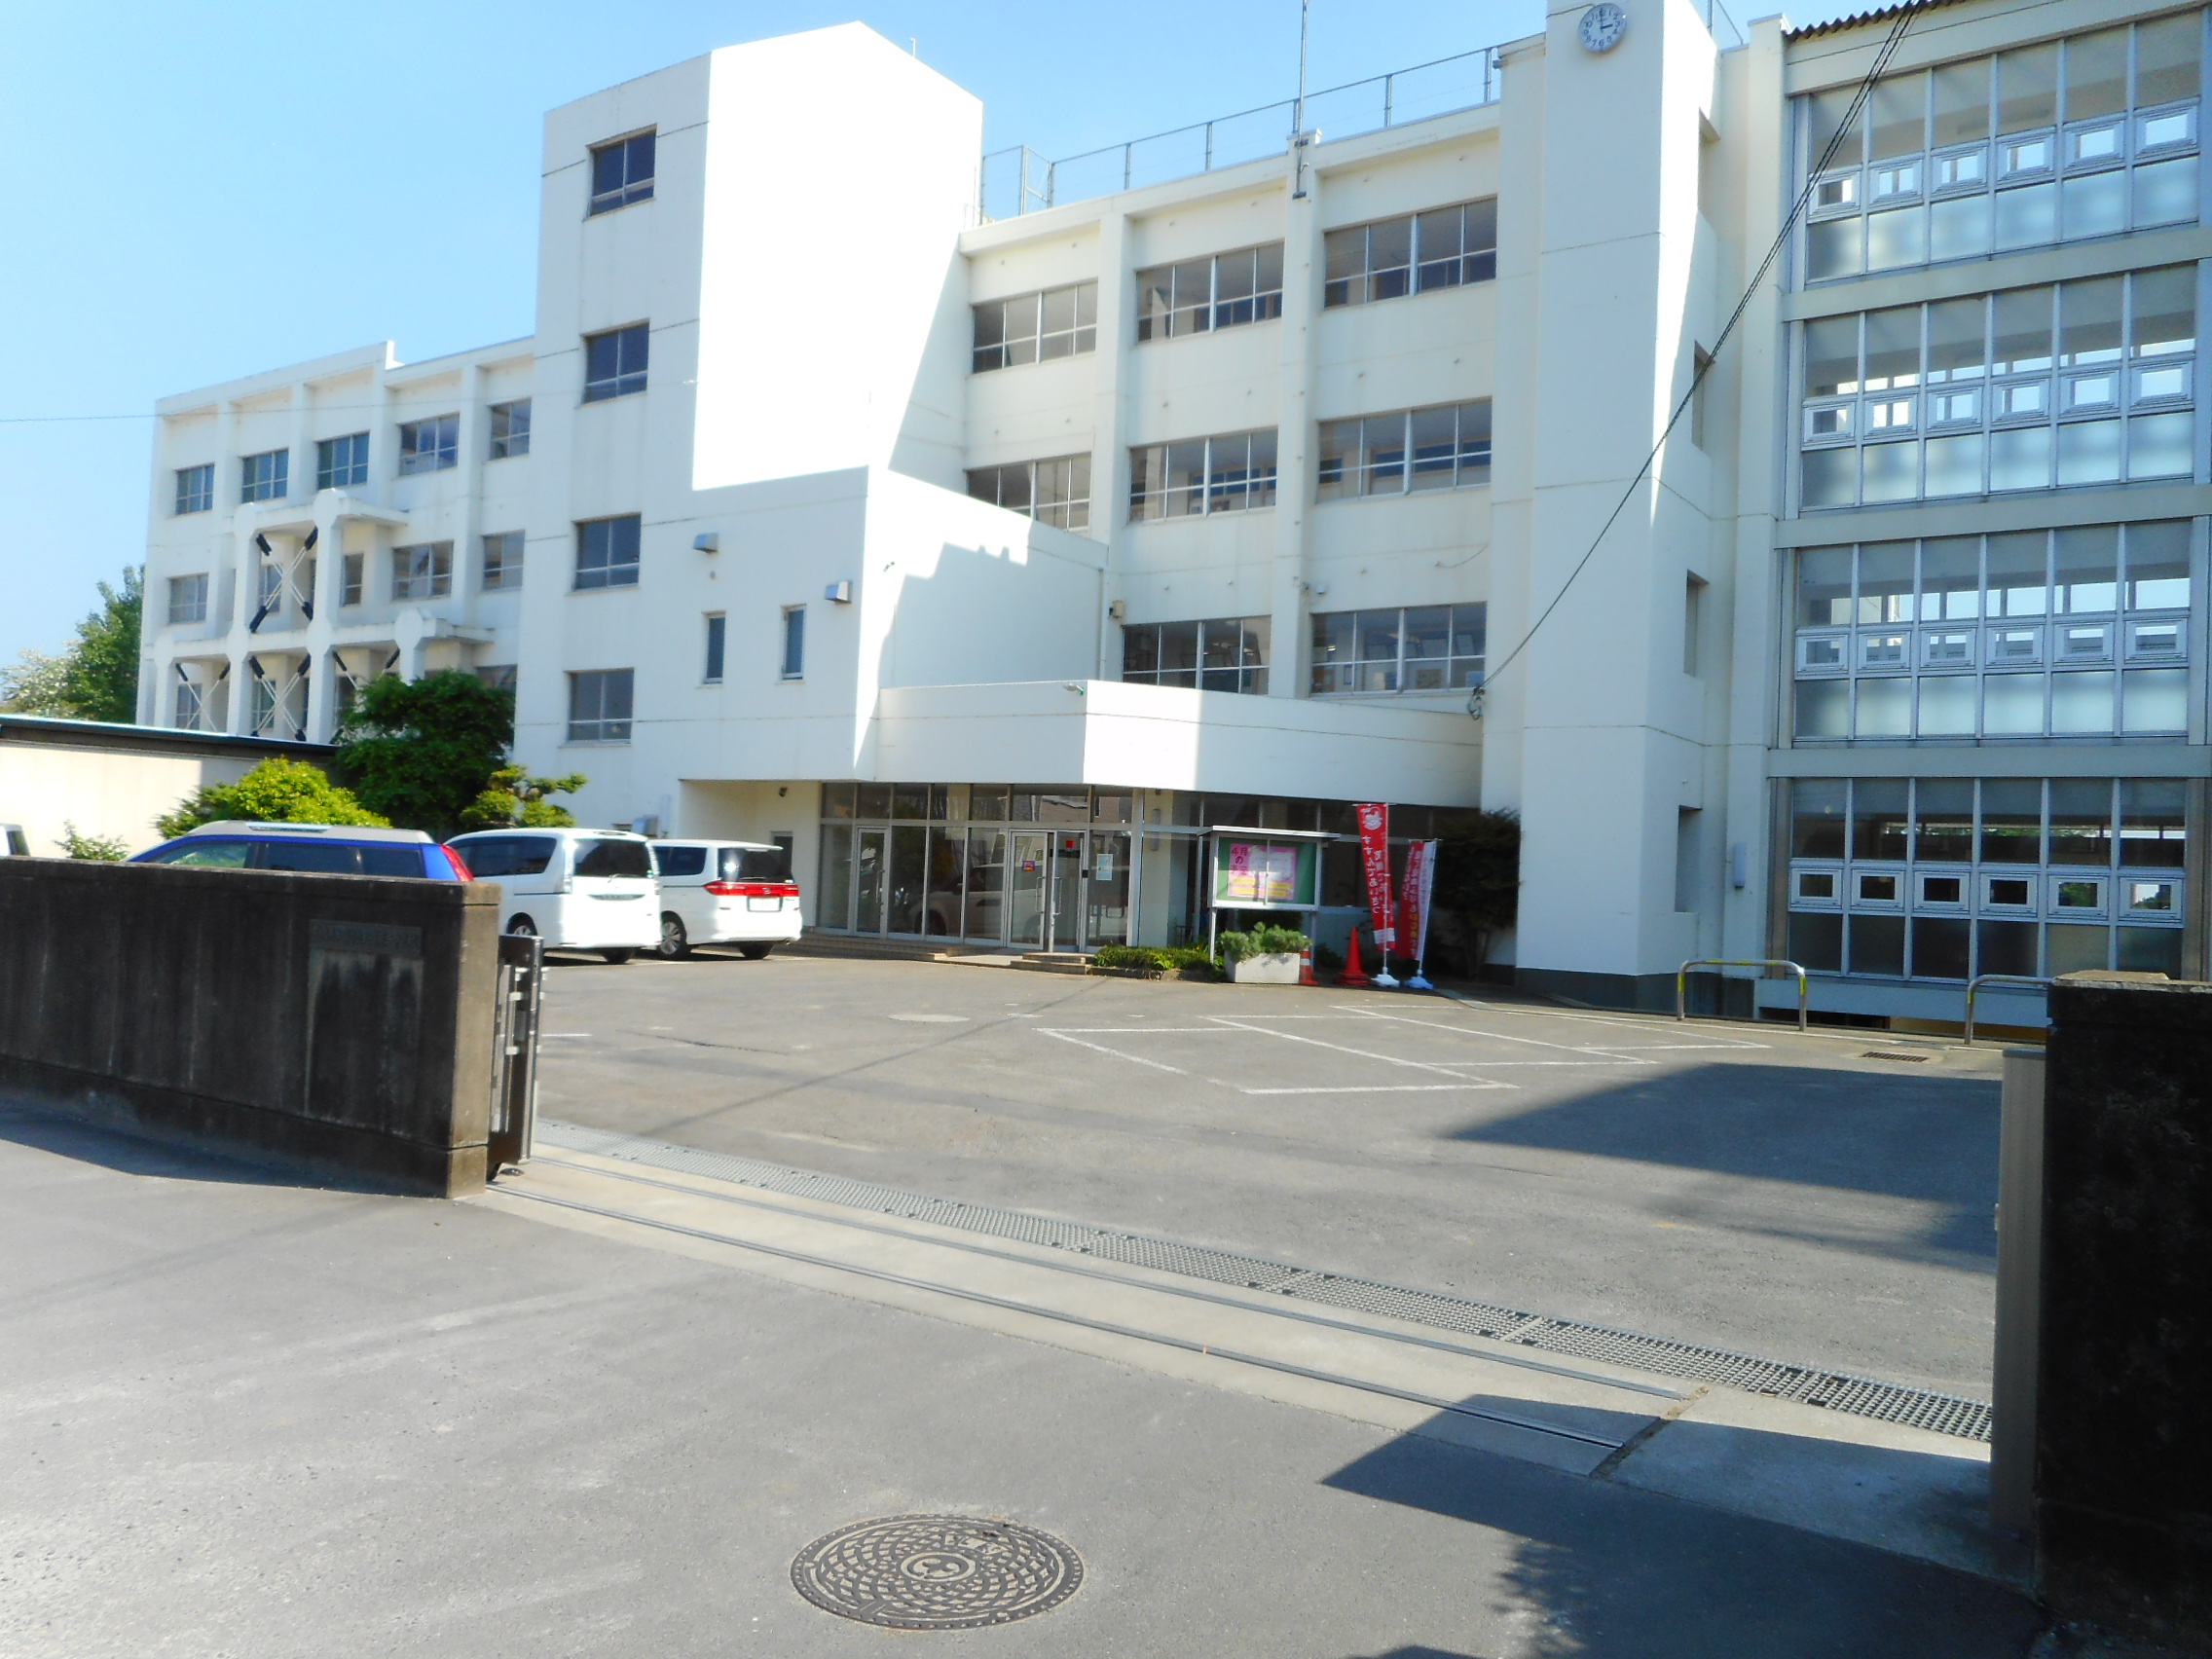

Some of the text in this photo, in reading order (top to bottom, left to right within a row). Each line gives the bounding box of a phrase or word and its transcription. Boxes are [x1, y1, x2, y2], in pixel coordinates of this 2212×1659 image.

[1235, 856, 1243, 865] の
[1362, 834, 1380, 914] すすんであいさつ
